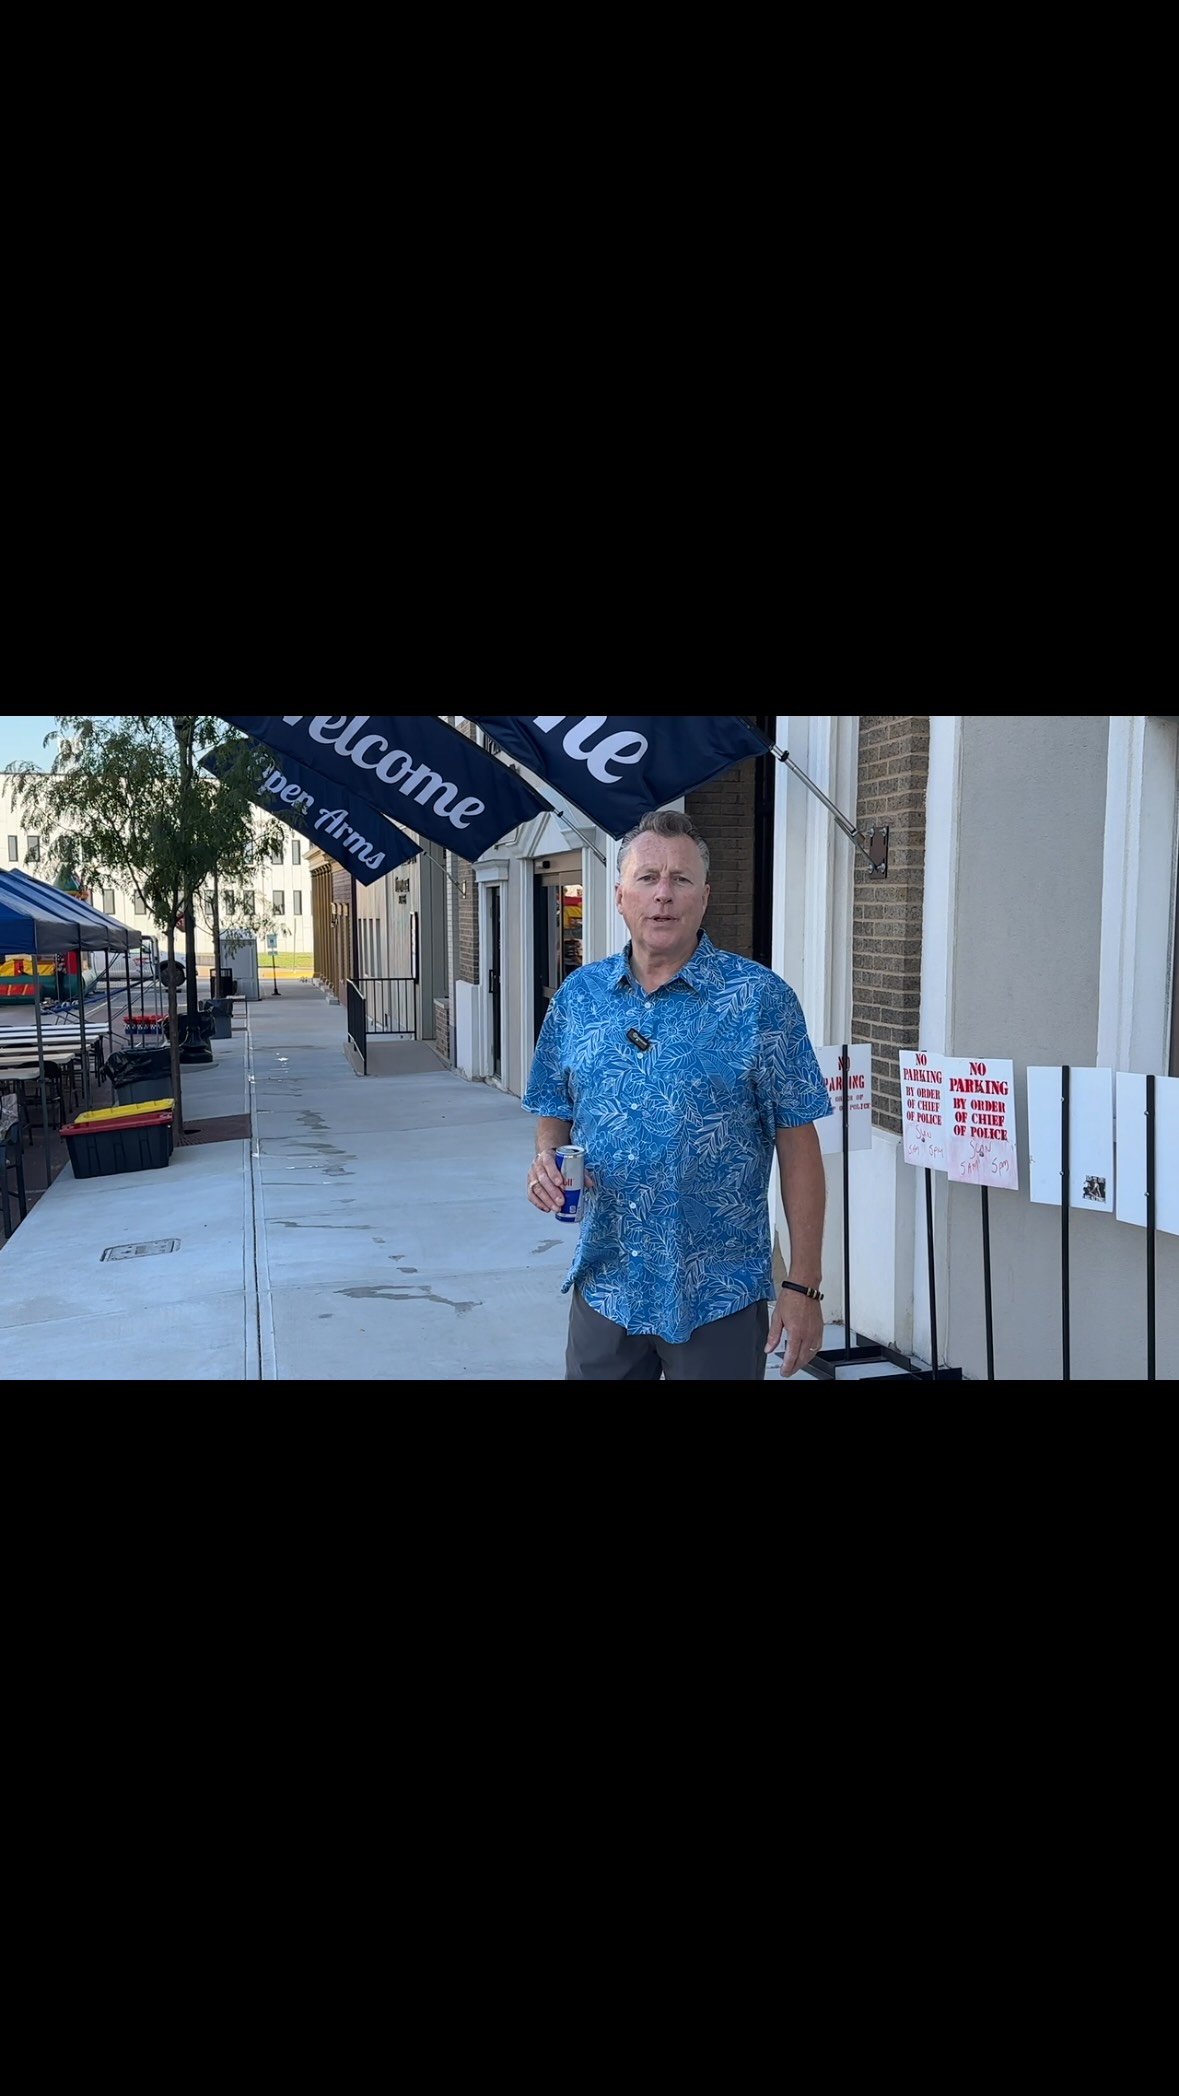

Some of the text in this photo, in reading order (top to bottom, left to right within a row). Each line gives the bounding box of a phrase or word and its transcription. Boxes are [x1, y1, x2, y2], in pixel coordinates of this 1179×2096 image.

[256, 754, 386, 870] pen Arms
[916, 1054, 927, 1066] NO
[903, 1068, 942, 1084] PARKING
[969, 1061, 987, 1077] NO
[824, 1074, 865, 1092] PARING
[949, 1078, 1009, 1096] PARKING
[906, 1086, 941, 1100] BY ORDER
[907, 1099, 940, 1112] OF CHIEF
[953, 1097, 1006, 1113] BY ORDER
[906, 1112, 942, 1126] OF POLICE
[955, 1111, 1005, 1127] OF CHIEF
[953, 1124, 1008, 1141] OF POLICE
